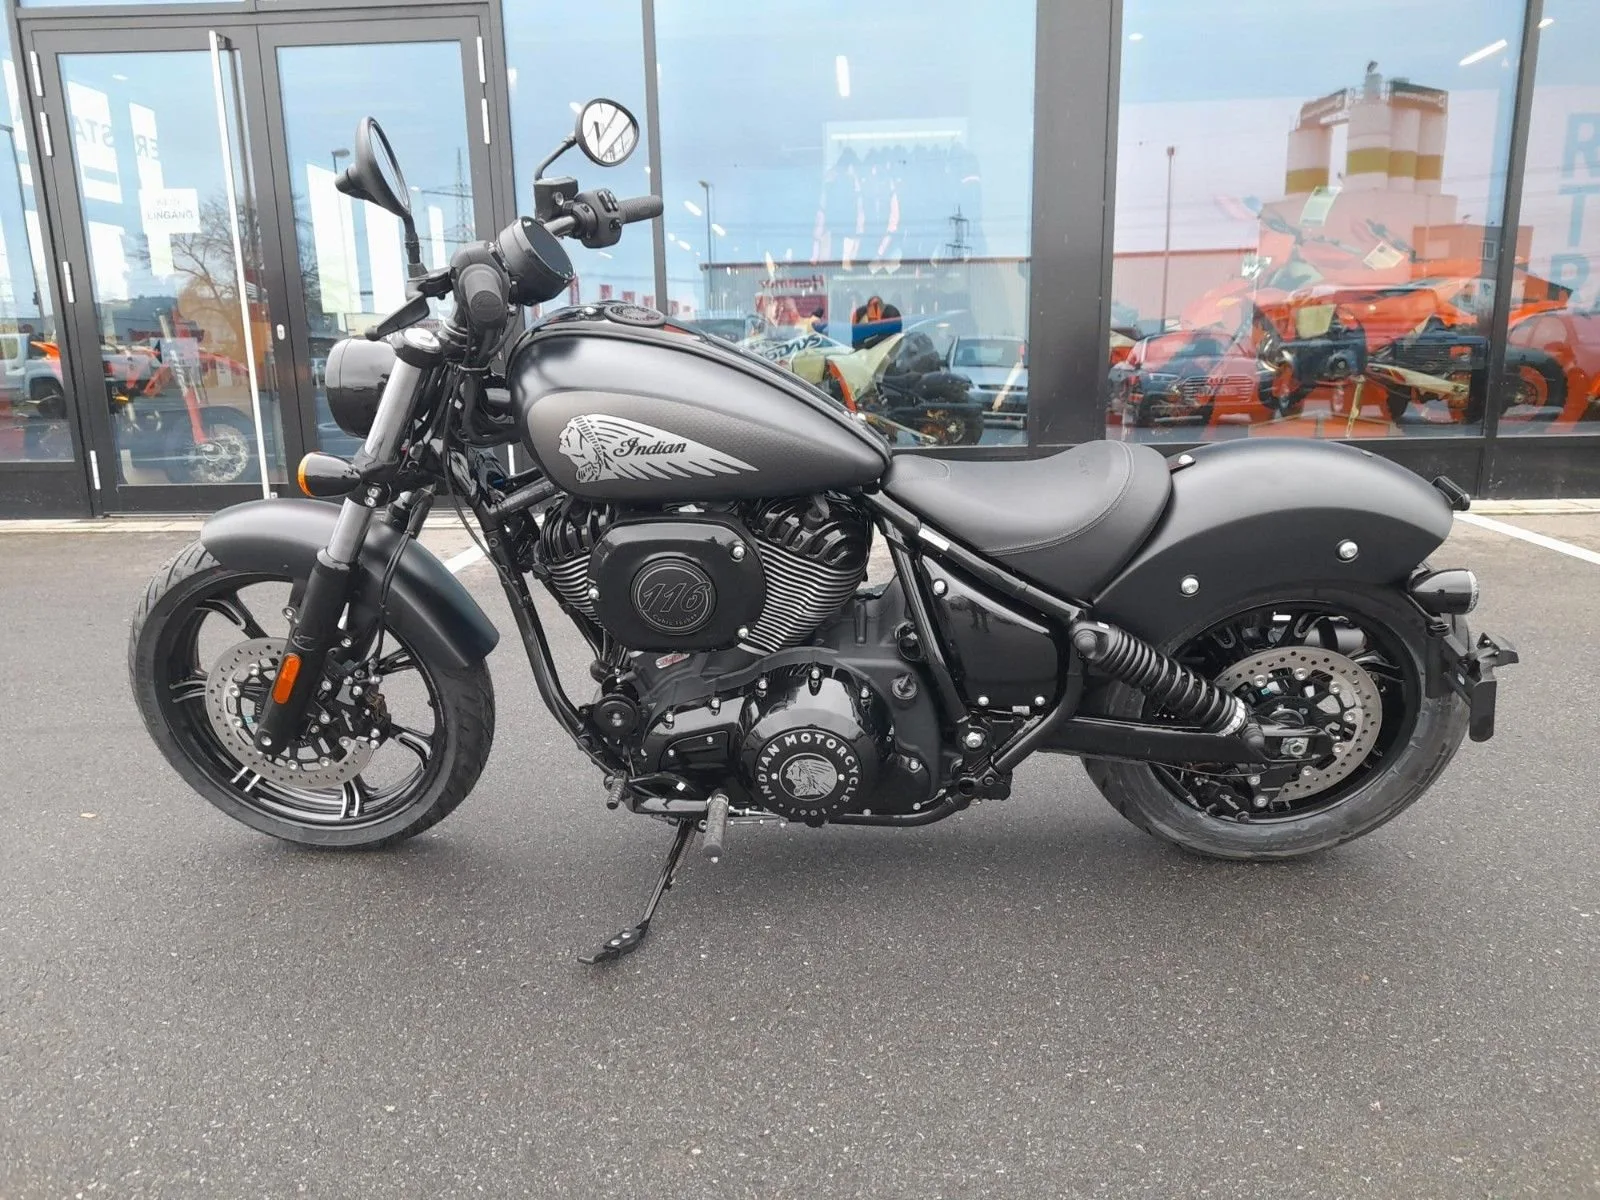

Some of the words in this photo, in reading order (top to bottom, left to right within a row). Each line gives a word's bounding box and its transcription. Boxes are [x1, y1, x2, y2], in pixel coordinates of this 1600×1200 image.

[613, 437, 686, 457] Indian
[640, 581, 711, 612] 116
[758, 743, 780, 801] INDIAN
[784, 732, 859, 802] MOTORCYCLE
